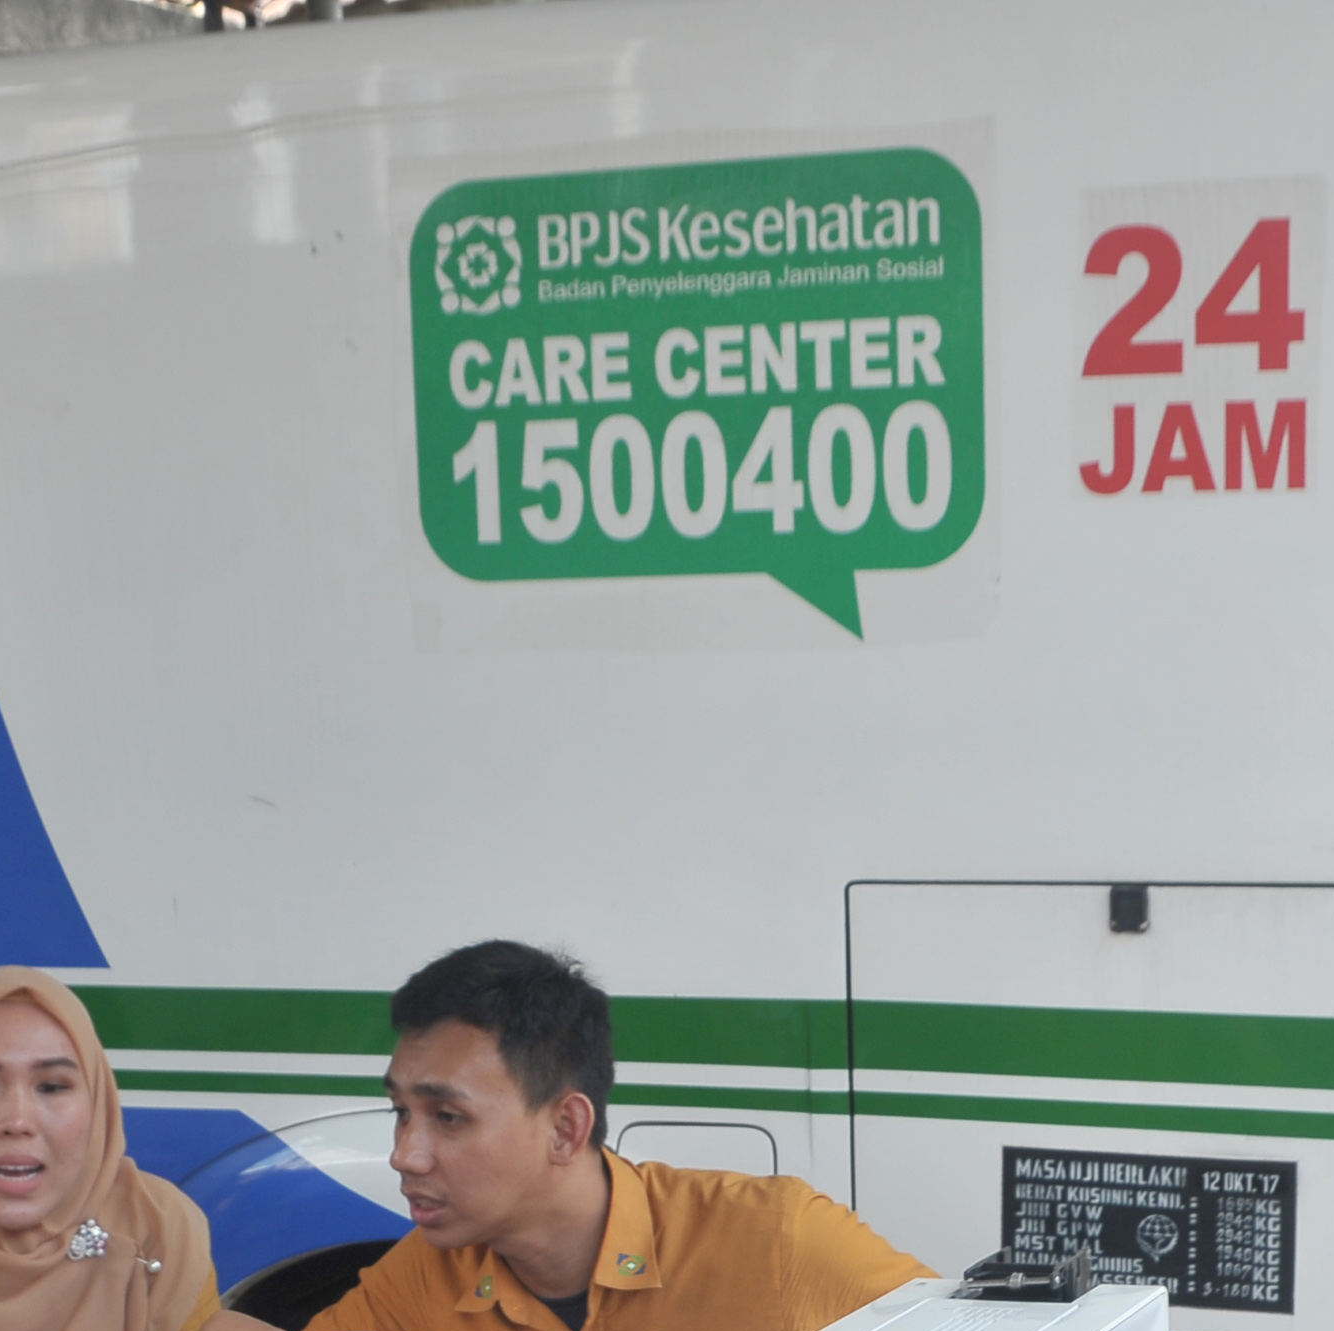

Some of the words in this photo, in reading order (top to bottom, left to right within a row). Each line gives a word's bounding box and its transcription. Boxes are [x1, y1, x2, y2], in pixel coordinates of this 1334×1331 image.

[537, 206, 651, 270] BPJS
[658, 193, 940, 263] Kesehatan
[537, 278, 606, 302] Badan
[611, 265, 772, 299] Penyelenggara
[777, 260, 871, 288] Jaminan
[877, 255, 945, 282] Sosial
[1079, 215, 1306, 378] 24
[448, 331, 633, 409] CARE
[653, 313, 946, 400] CENTER
[451, 400, 955, 546] 1500400
[1077, 396, 1308, 497] JAM
[1015, 1158, 1066, 1180] MASA
[1202, 1171, 1221, 1192] 12
